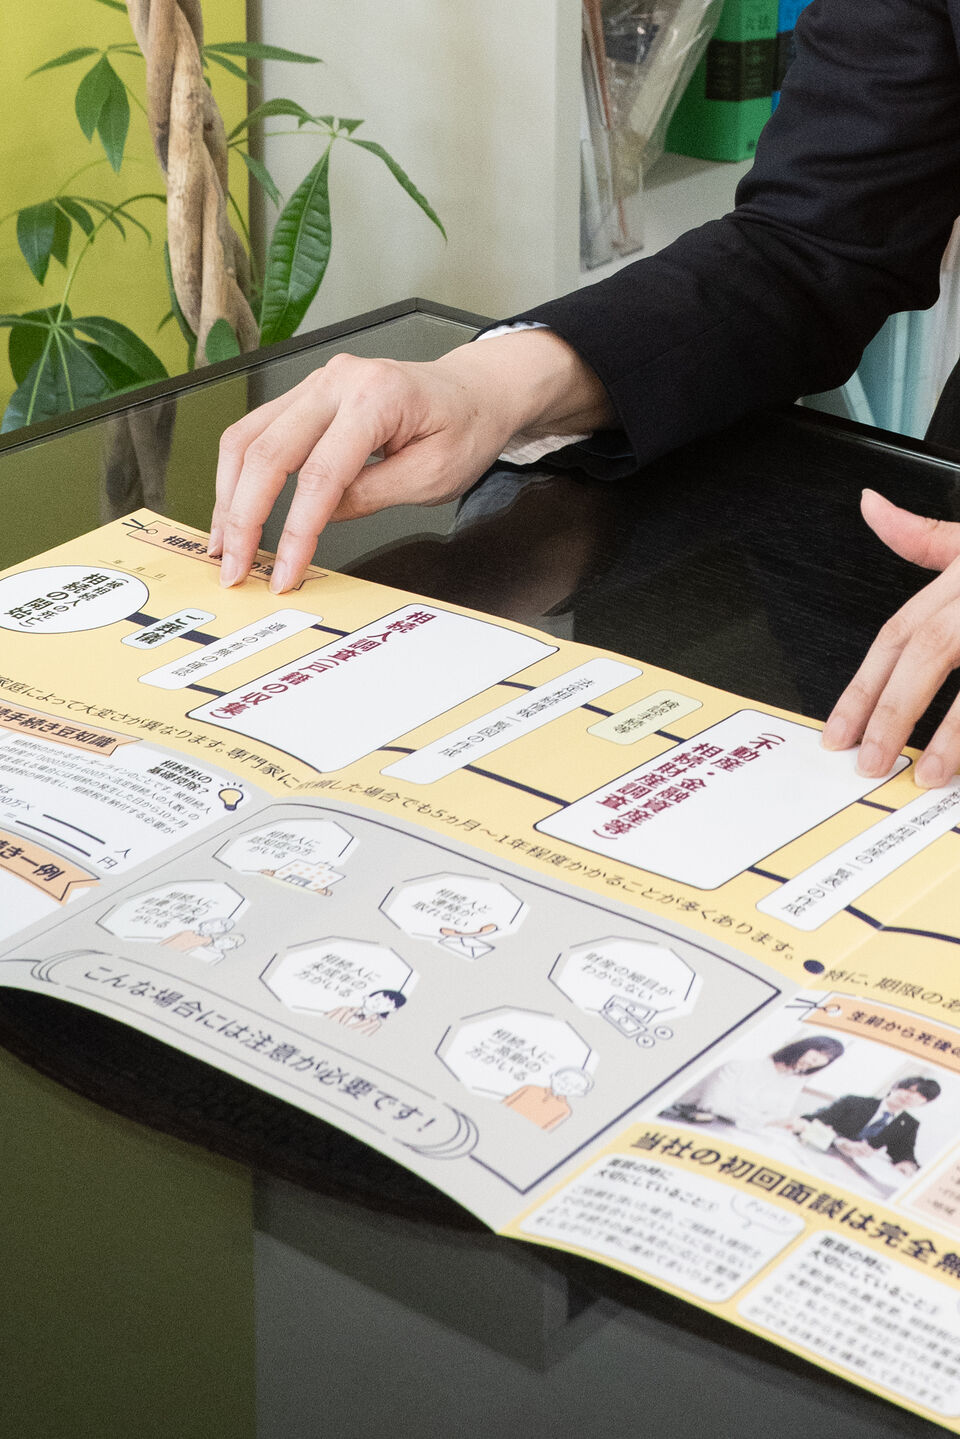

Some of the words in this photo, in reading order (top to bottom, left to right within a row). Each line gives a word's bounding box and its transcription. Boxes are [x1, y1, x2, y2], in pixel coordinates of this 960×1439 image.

[3, 572, 110, 620] 相続の開始
[134, 615, 204, 645] ご葬儀
[171, 621, 288, 677] 遺言の有無の確認
[597, 742, 724, 811] 相続財産調査
[83, 965, 437, 1134] こんな場合には注意が必要です！
